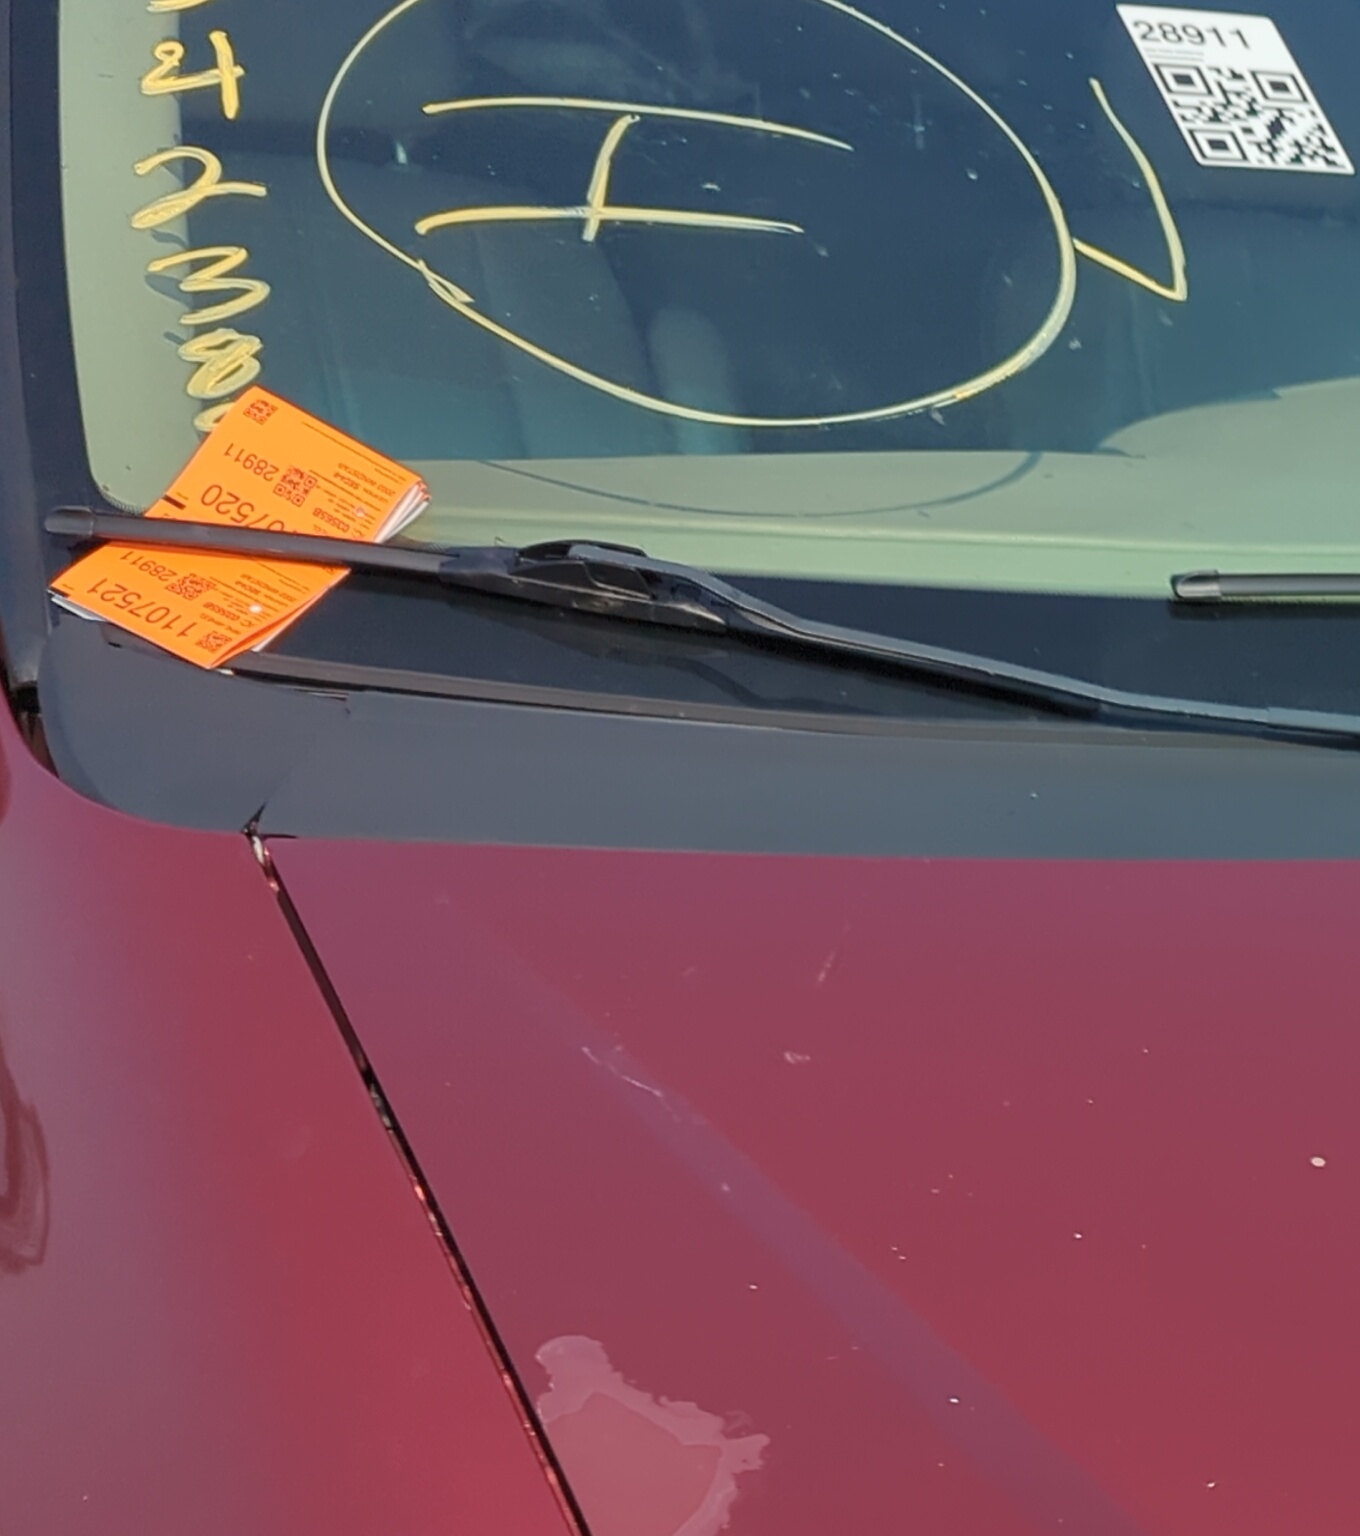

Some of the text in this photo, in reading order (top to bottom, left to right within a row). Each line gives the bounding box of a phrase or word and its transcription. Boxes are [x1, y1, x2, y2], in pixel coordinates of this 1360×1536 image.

[1133, 20, 1251, 50] 28911
[222, 442, 280, 482] 28911
[200, 484, 292, 534] 07520
[118, 550, 178, 582] 28911
[87, 577, 198, 638] 1107521
